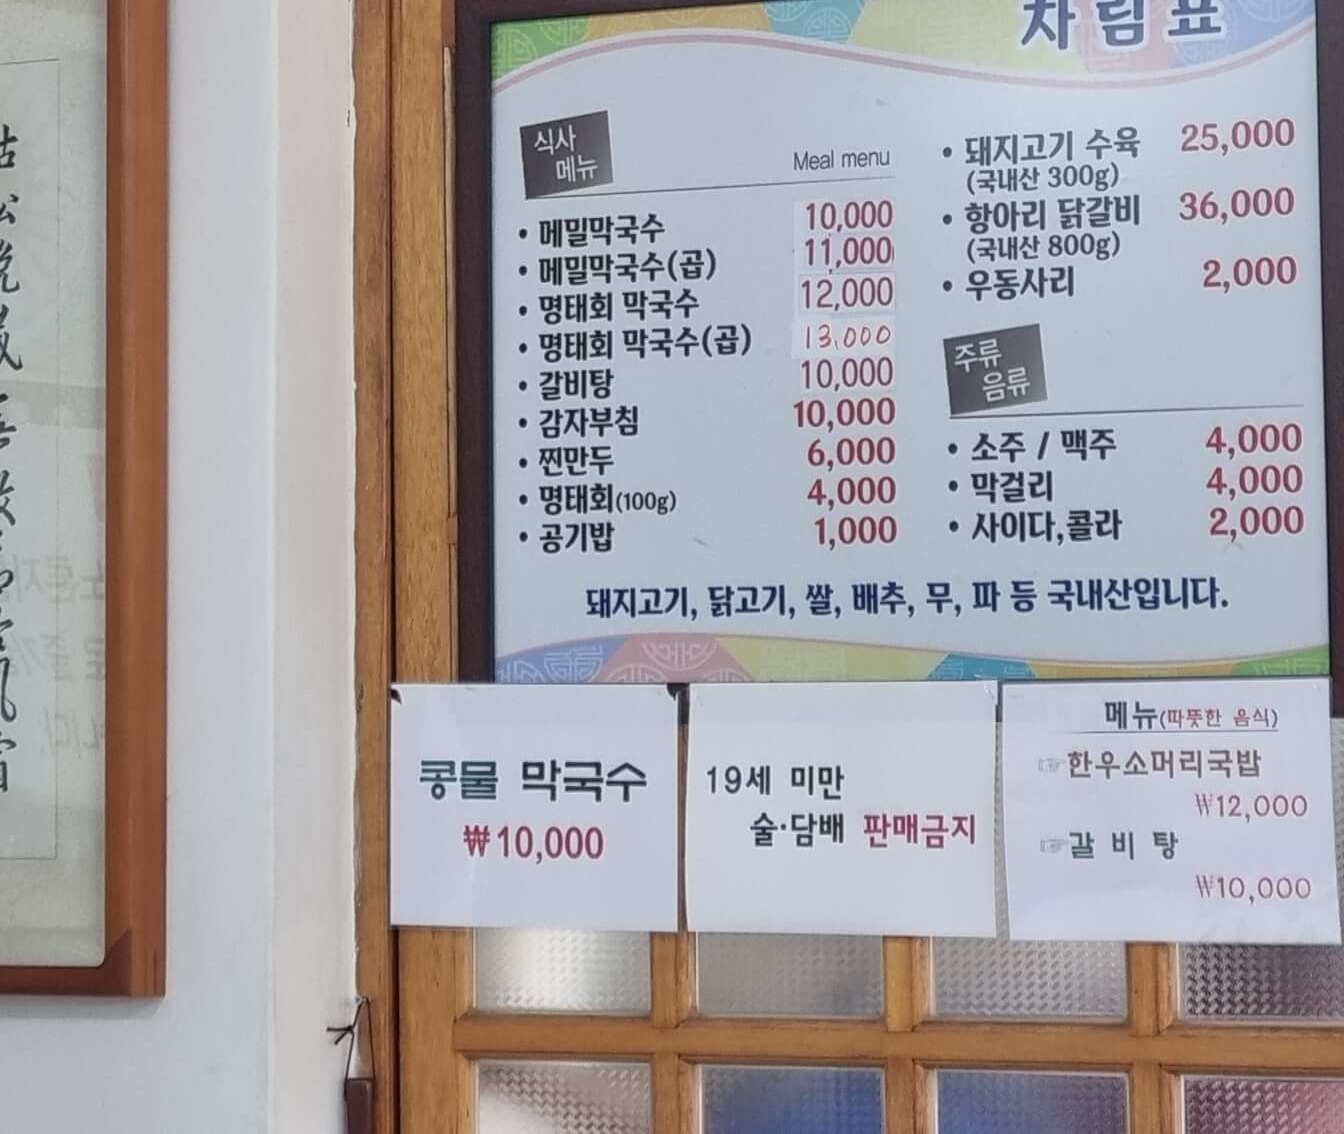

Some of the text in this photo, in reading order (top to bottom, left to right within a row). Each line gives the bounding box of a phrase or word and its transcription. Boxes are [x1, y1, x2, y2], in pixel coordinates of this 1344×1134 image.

[534, 124, 576, 155] 식사
[964, 126, 1141, 167] 돼지고기 수육
[1180, 118, 1295, 156] 25,000
[556, 154, 599, 183] 메뉴
[793, 149, 890, 171] Meal menu
[967, 162, 1120, 195] (국내산 300g)
[805, 199, 893, 232] 10,000
[964, 195, 1141, 235] 항아리 닭갈비
[1179, 186, 1295, 225] 36,000
[538, 213, 665, 247] 메밀막국수
[967, 231, 1121, 263] (국내산 800g)
[538, 247, 717, 285] 메밀막국수(곱)
[804, 235, 893, 269] 11,000
[966, 266, 1075, 302] 우동사리
[1203, 255, 1297, 294] 2,000
[538, 287, 700, 325] 명태회 막국수
[800, 276, 893, 311] 12,000
[538, 323, 753, 363] 명태회 막국수(곱)
[805, 323, 892, 352] 13,000
[954, 338, 1002, 373] 주류
[538, 369, 614, 401] 갈비탕
[800, 356, 893, 392] 10,000
[982, 366, 1030, 403] 음류
[538, 405, 639, 439] 감자부침
[793, 396, 896, 432] 10,000
[807, 436, 896, 472] 6,000
[971, 430, 1026, 463] 소주
[1060, 428, 1117, 461] 맥주
[1205, 423, 1303, 459] 4,000
[538, 445, 615, 477] 찐만두
[538, 483, 677, 515] 명태회(100g)
[807, 475, 897, 511] 4,000
[971, 470, 1054, 504] 막걸리
[1206, 464, 1304, 501] 4,000
[538, 521, 615, 554] 공기밥
[814, 515, 898, 550] 1,000
[971, 508, 1123, 546] 사이다,콜라
[1209, 505, 1305, 543] 2,000
[586, 576, 1229, 621] 돼지고기, 닭고기, 쌀, 배추, 무, 파 등 국내산입니다.
[1233, 707, 1279, 729] 음식)
[419, 759, 647, 803] 콩물 막국수
[705, 764, 844, 799] 19세 미만
[1067, 750, 1261, 779] 한우소머리국밥
[1195, 793, 1308, 823] ₩12,000
[463, 825, 604, 864] ₩10,000
[863, 813, 976, 849] 판매금지
[1196, 874, 1312, 906] ₩10,000
